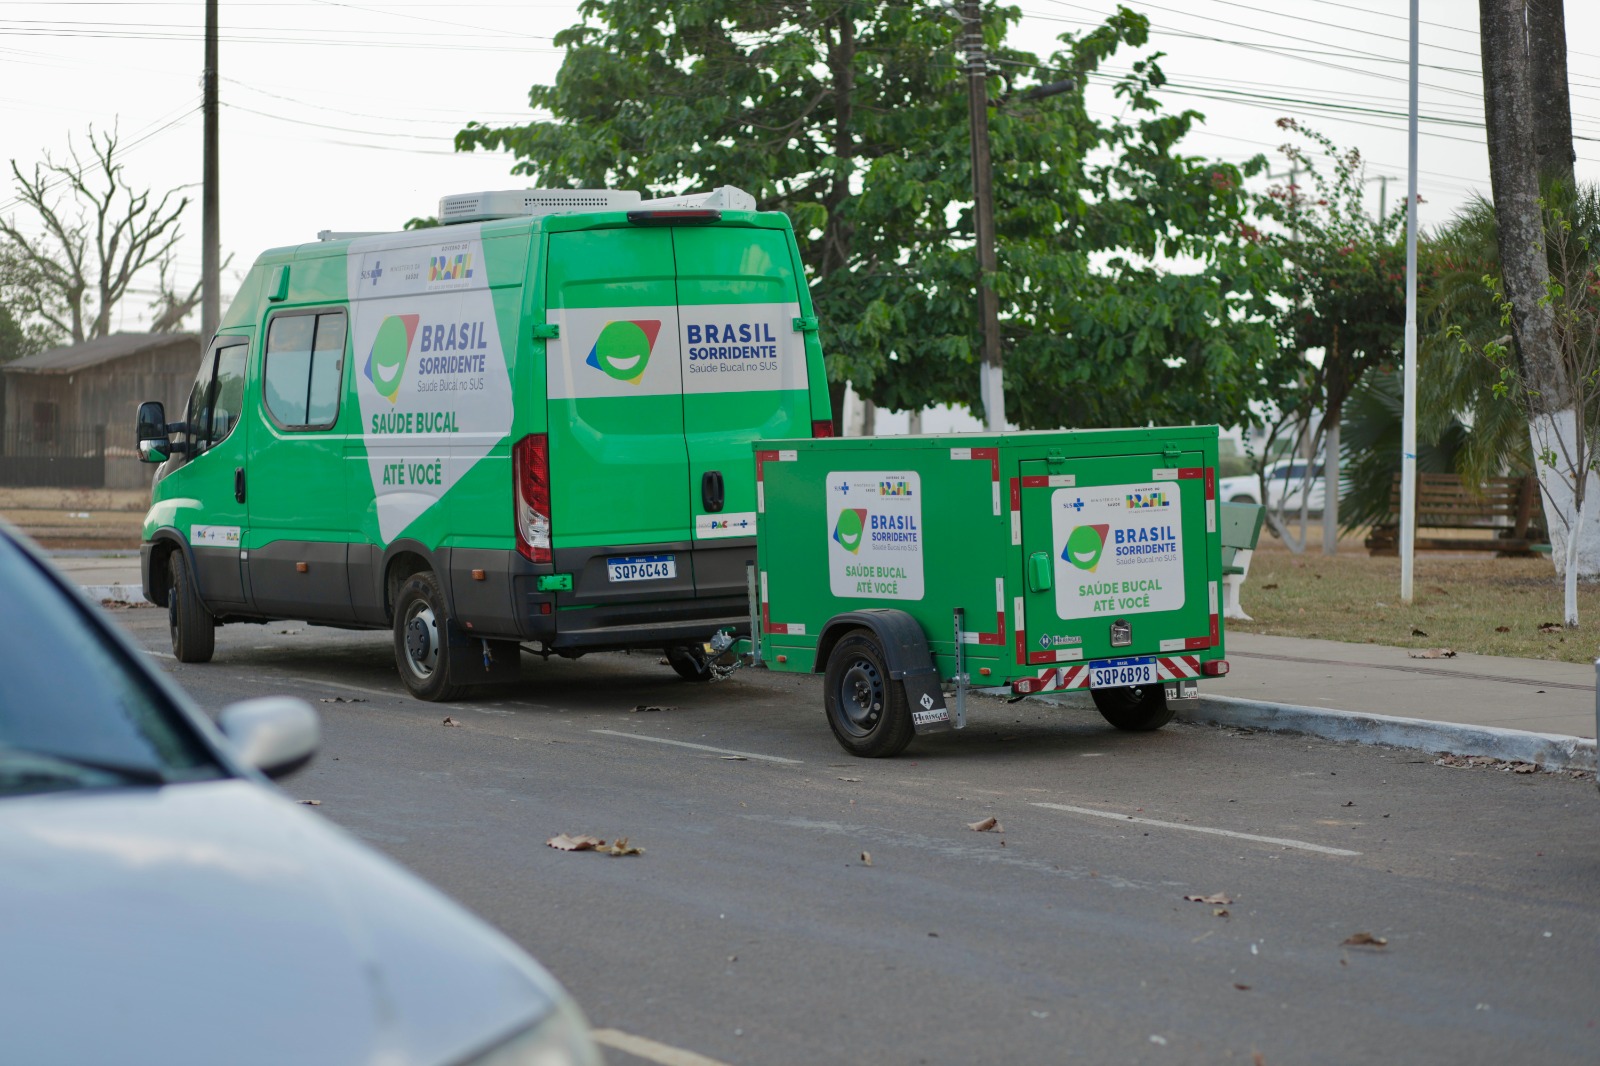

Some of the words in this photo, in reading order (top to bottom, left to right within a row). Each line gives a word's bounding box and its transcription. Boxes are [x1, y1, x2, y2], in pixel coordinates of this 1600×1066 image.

[428, 253, 473, 282] BRASIL
[420, 321, 487, 353] BRASIL
[687, 323, 776, 344] BRASIL
[689, 345, 777, 361] SORRIDENTE
[418, 354, 486, 376] SORRIDENTE
[689, 362, 718, 374] Saúde
[720, 361, 745, 373] Bucal
[746, 363, 758, 372] no
[759, 361, 778, 372] SUS
[439, 378, 458, 391] Bucal
[459, 380, 468, 391] no
[469, 377, 484, 391] SUS
[371, 408, 413, 434] SAÚDE
[416, 411, 459, 433] BUCAL
[382, 459, 405, 485] ATÉ
[408, 458, 442, 485] VOCÊ
[879, 481, 913, 496] BRASIL
[1126, 492, 1170, 509] BRASIL
[711, 520, 728, 529] PAC
[871, 515, 917, 530] BRASIL
[871, 532, 917, 542] SORRIDENTE
[1114, 526, 1176, 544] BRASIL
[887, 543, 901, 551] Bucal
[908, 544, 918, 552] SUS
[1115, 542, 1176, 556] SORRIDENTE
[1137, 556, 1154, 564] Bucal
[1163, 554, 1177, 562] SUS
[614, 563, 669, 579] SQP6C48
[845, 564, 875, 578] SAÚDE
[876, 566, 907, 579] BUCAL
[856, 579, 873, 593] ATÉ
[874, 580, 898, 594] VOCÊ
[1078, 581, 1119, 597] SAÚDE
[1122, 579, 1162, 593] BUCAL
[1093, 596, 1115, 612] ATÉ
[1118, 593, 1150, 610] VOCÊ
[1096, 666, 1150, 686] SQP6B98
